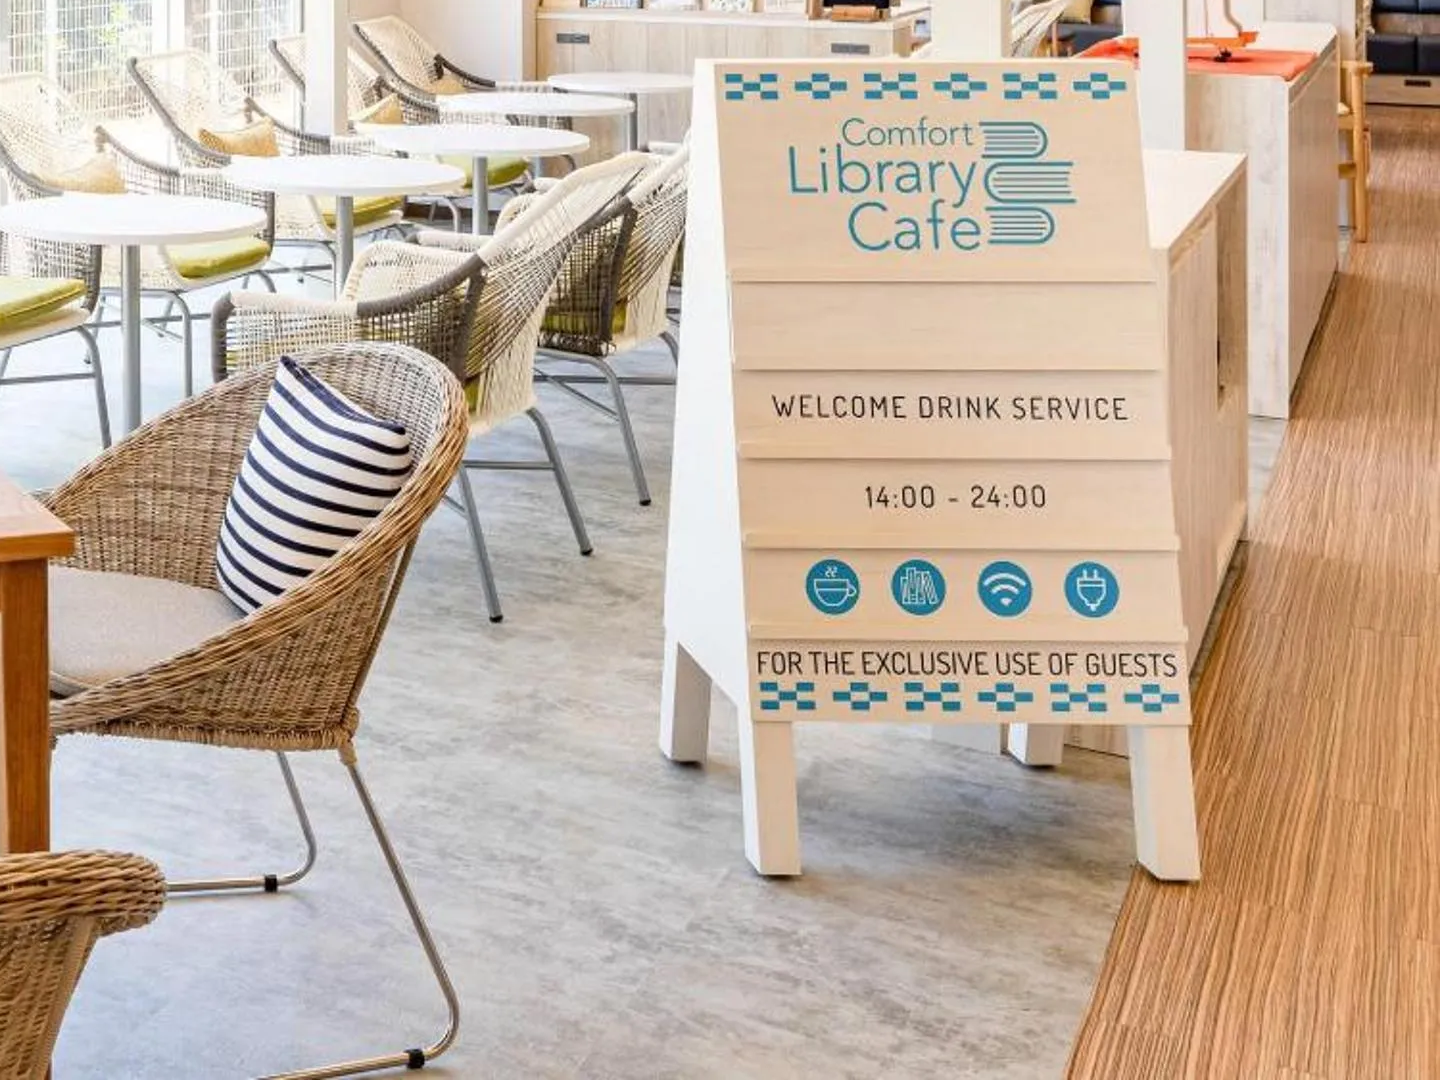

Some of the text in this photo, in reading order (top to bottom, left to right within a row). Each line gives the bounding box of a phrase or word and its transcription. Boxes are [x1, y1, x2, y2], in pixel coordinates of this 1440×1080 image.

[842, 116, 974, 147] Comfort
[788, 143, 976, 208] Library
[848, 199, 981, 251] Cafe
[772, 395, 1128, 421] WELCOME DRINK SERVICE
[865, 485, 936, 509] 14:00
[970, 485, 1046, 509] 24:00
[757, 651, 1178, 677] FOR THE EXCLUSIVE USE OF GUESTS
